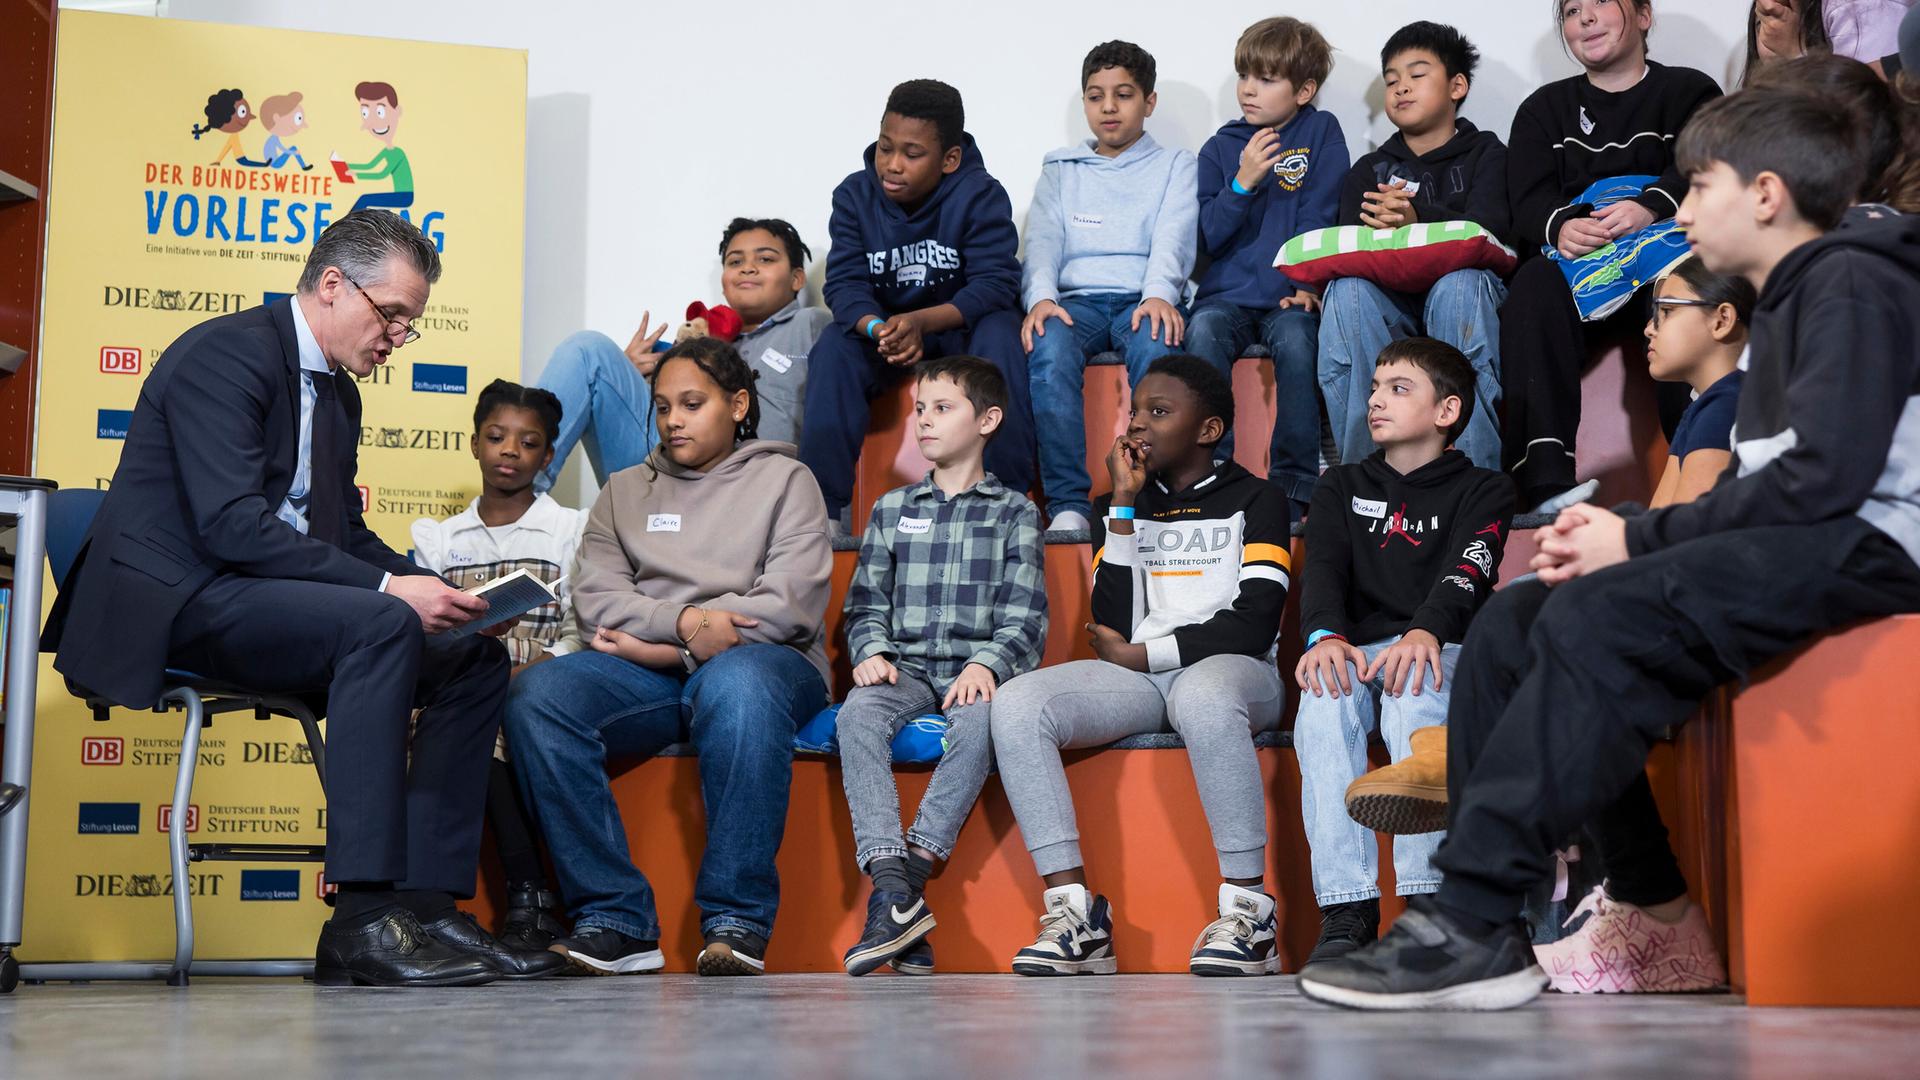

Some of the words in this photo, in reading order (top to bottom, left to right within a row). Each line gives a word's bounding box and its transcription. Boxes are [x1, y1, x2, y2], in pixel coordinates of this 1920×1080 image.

[145, 163, 183, 185] DER
[192, 166, 332, 195] BUNDESWEITE
[145, 190, 445, 253] VORLESEG
[146, 244, 163, 253] Eine
[165, 246, 200, 256] Initiative
[219, 249, 234, 258] DIE
[236, 250, 254, 259] ZEIT
[260, 251, 300, 262] STIFTUNG
[104, 286, 149, 308] DIE
[188, 291, 246, 313] ZEIT
[440, 305, 469, 315] BAHN
[412, 317, 469, 332] FTUNG
[105, 351, 136, 370] DB
[414, 382, 443, 391] Stiftung
[443, 383, 465, 392] Lesen
[100, 429, 127, 437] Stiftun
[410, 429, 465, 451] ZEIT
[378, 487, 432, 498] DEUTSCHE
[436, 490, 464, 500] BAHN
[377, 498, 464, 516] STIFTUNG
[652, 517, 678, 528] Claire
[1168, 557, 1222, 566] STREETCOURT
[133, 737, 183, 748] DEUTSCH
[87, 741, 119, 761] DB
[132, 750, 226, 767] STIFTNG
[243, 742, 289, 764] DIE
[209, 805, 265, 815] DEUTSCHE
[270, 806, 300, 815] BAHN
[81, 823, 112, 833] Stiftung
[207, 817, 300, 833] STIFTUNG
[75, 874, 125, 897] DIE
[243, 890, 273, 899] Stiftung
